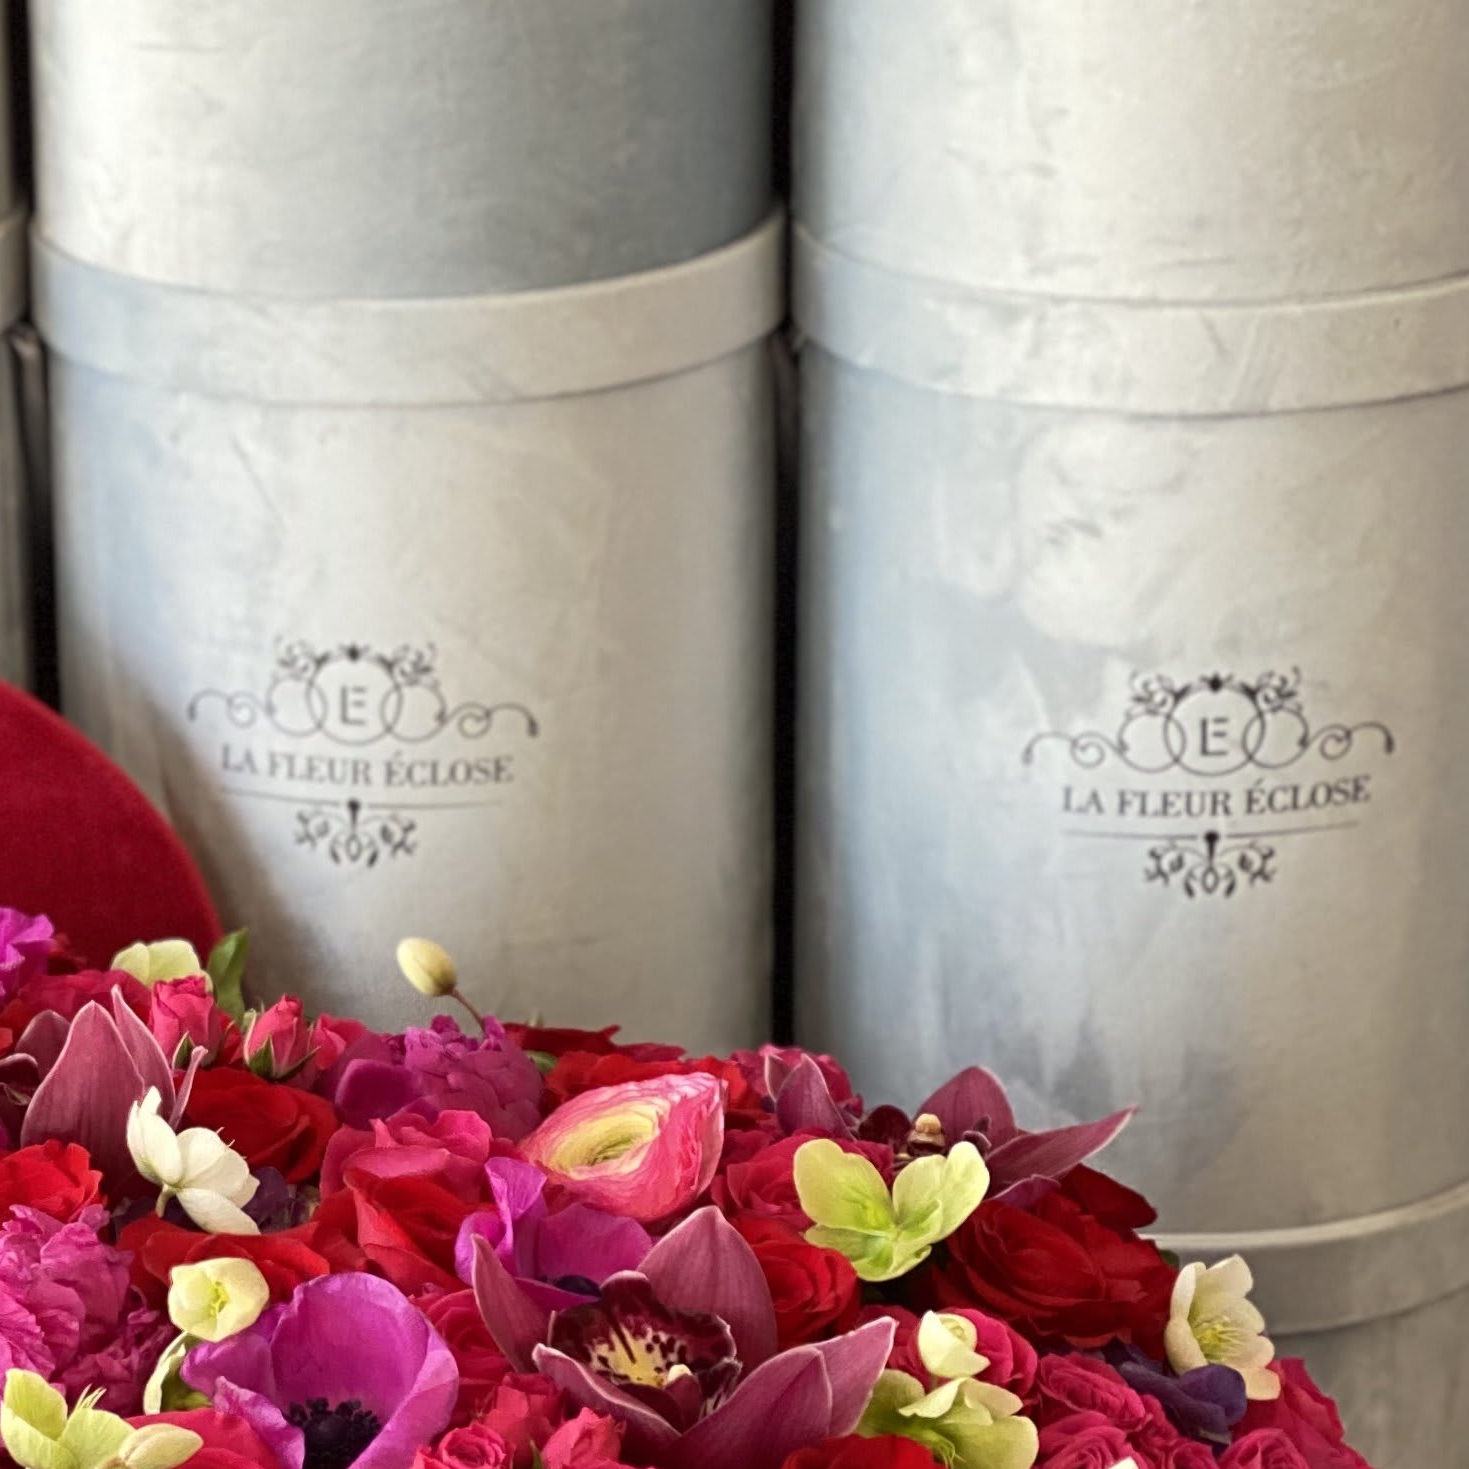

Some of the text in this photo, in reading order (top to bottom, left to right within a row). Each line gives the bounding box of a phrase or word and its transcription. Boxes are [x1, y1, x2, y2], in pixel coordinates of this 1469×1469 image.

[222, 744, 515, 788] LA FLEUR ÉCLOSE
[1061, 774, 1373, 819] LA FLEUR ÉCLOSE
